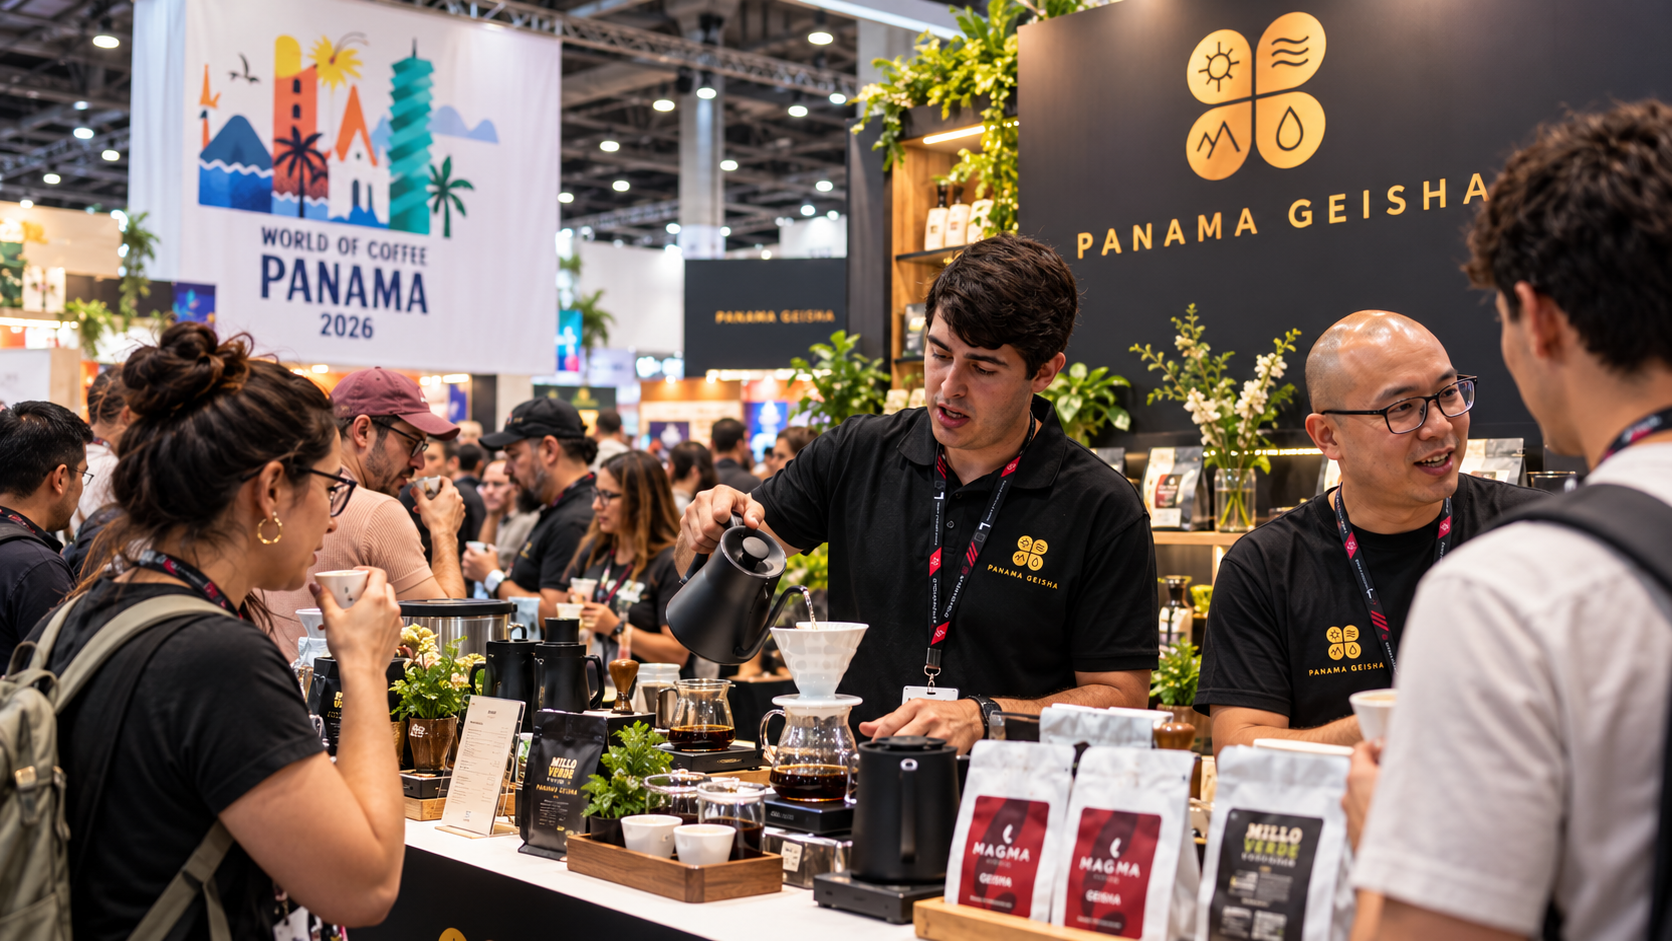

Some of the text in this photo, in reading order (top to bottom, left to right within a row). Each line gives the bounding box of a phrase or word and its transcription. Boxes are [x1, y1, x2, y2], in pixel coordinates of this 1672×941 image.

[1077, 172, 1490, 259] PANAMA GEISHA
[261, 226, 428, 266] WORLD OF COFFEE
[261, 254, 428, 314] PANAMA
[320, 313, 374, 339] 2026
[715, 309, 836, 324] PANAMA GEISHA
[1026, 574, 1059, 589] GEISHA
[1308, 662, 1385, 677] PANAMA GEISHA
[550, 756, 578, 769] MILLO
[1245, 822, 1304, 844] MILLO
[972, 841, 1031, 863] MAGMA
[1243, 837, 1301, 860] VERDE
[1078, 856, 1141, 878] MAGMA
[979, 872, 1013, 888] GEISHA
[1085, 889, 1122, 906] GEISHA
